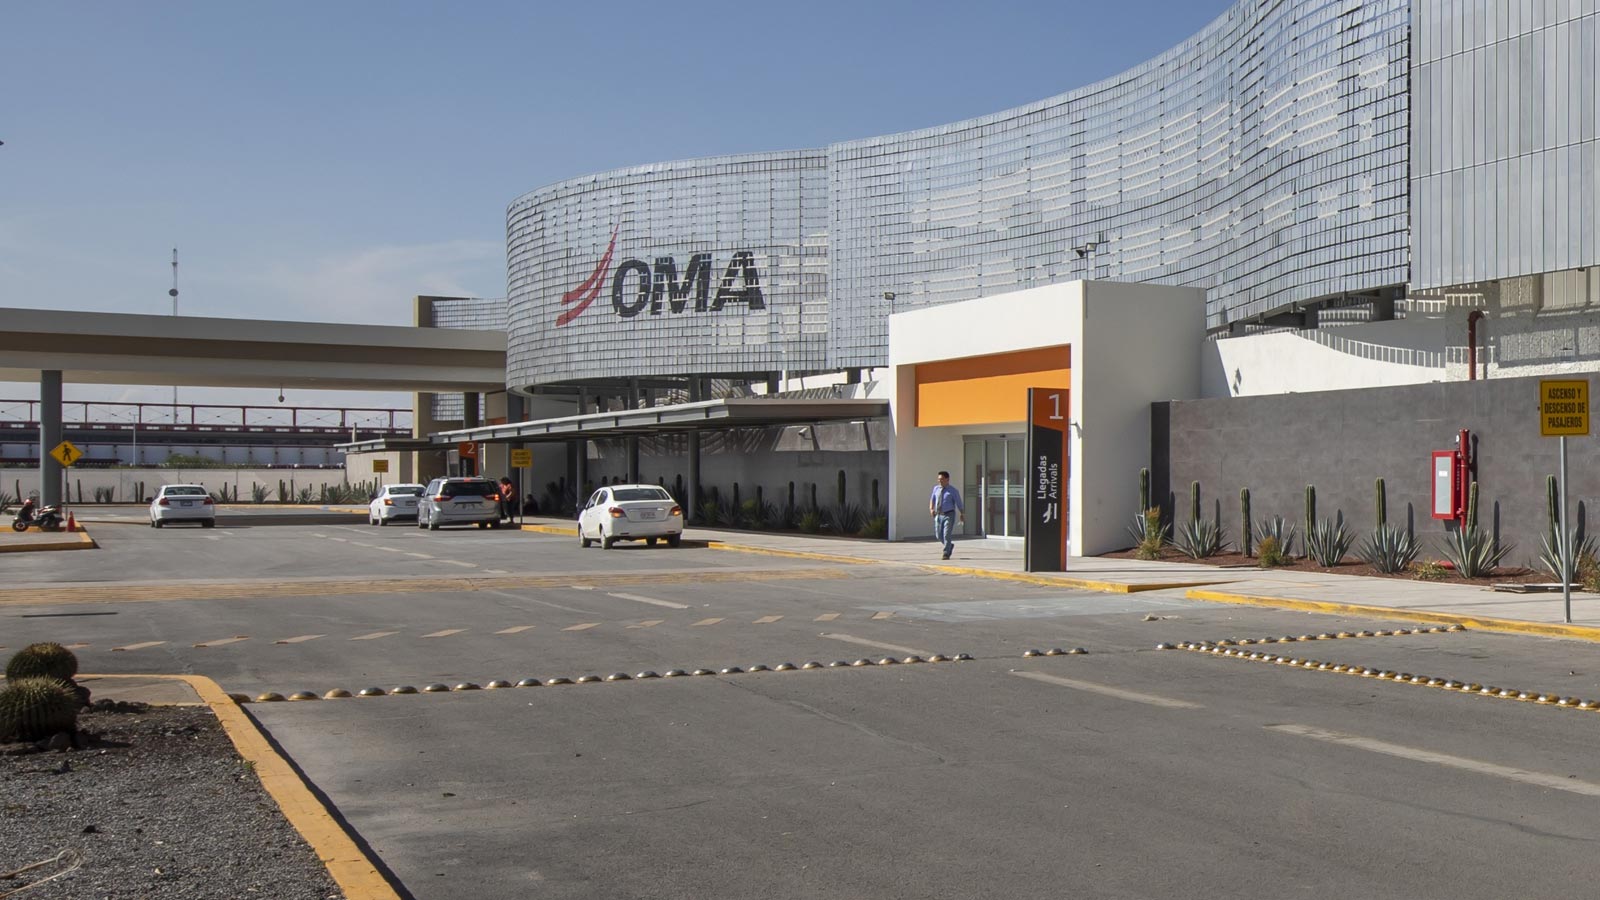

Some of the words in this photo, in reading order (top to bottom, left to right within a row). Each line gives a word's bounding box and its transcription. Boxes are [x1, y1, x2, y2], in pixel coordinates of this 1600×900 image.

[612, 251, 766, 318] OMA
[1548, 388, 1575, 399] ASCENSO
[1577, 388, 1582, 399] Y
[1048, 393, 1064, 420] 1
[1544, 402, 1575, 414] DESCENSO
[1577, 402, 1585, 414] DE
[1548, 417, 1582, 428] PASAJEROS
[467, 442, 476, 454] 2
[1037, 455, 1050, 499] Llegadas
[1048, 463, 1058, 499] Arrivals
